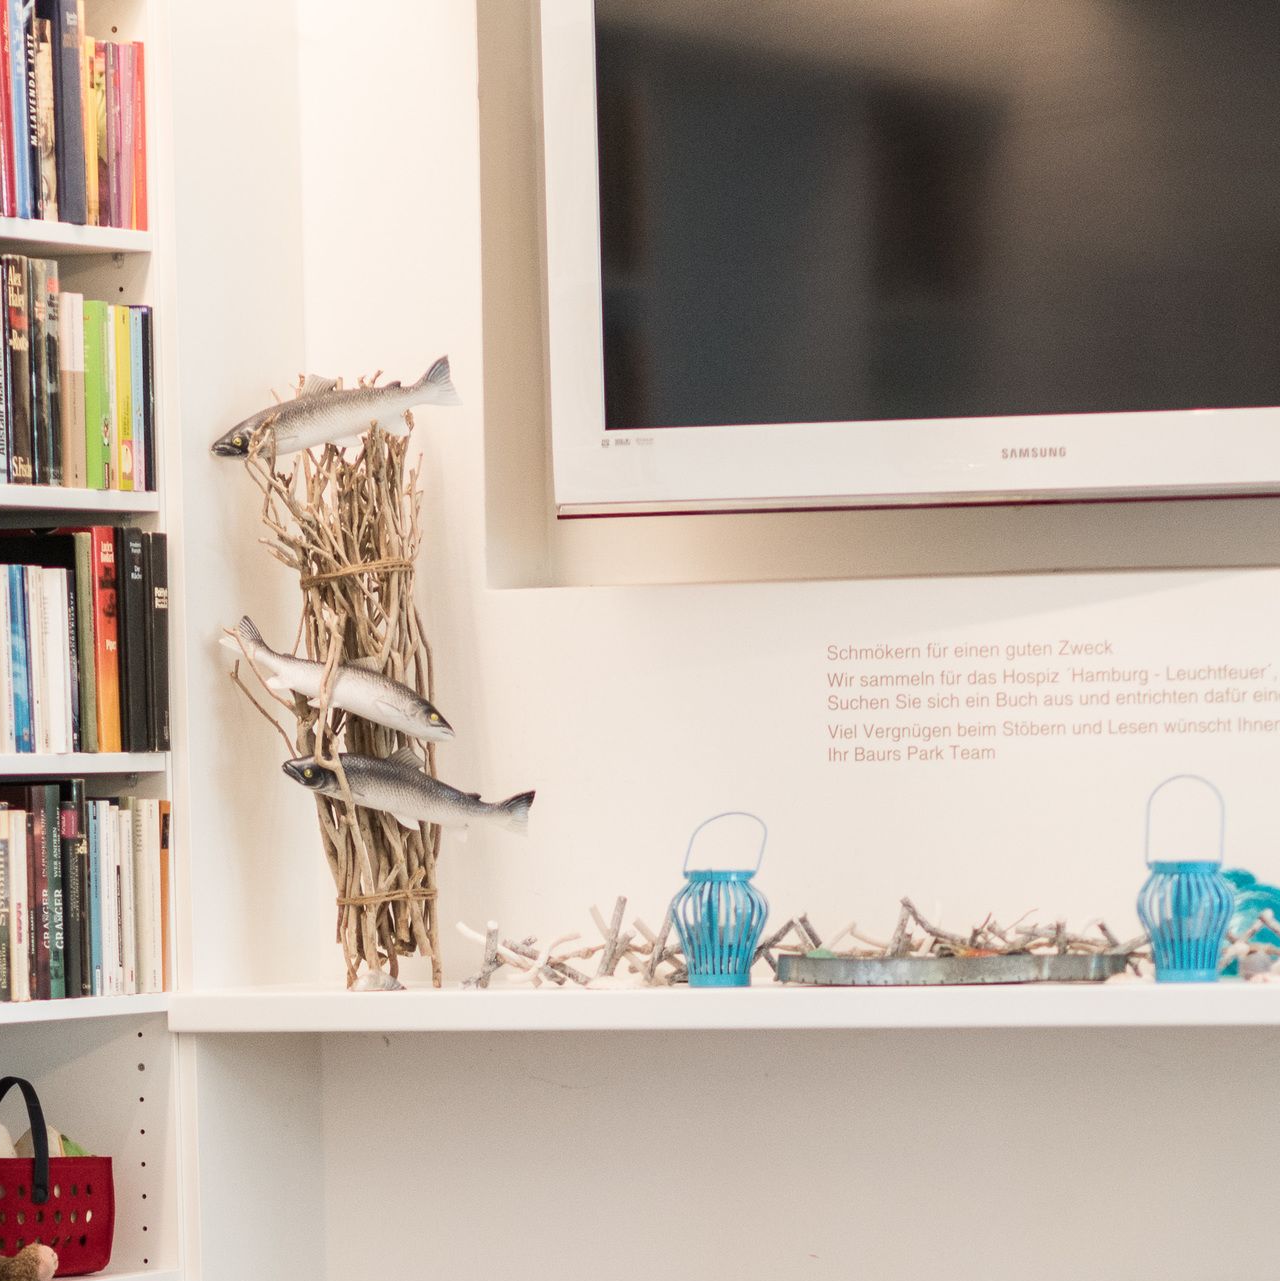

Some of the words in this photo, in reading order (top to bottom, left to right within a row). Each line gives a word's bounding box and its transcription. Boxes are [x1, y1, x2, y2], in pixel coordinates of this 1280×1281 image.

[1001, 446, 1067, 460] SAMSUNG
[827, 643, 921, 661] Schmökern
[927, 642, 949, 659] für
[954, 642, 999, 658] einen
[1006, 641, 1052, 660] guten
[827, 672, 854, 688] Wir
[860, 669, 935, 687] sammeln
[940, 669, 962, 685] für
[967, 668, 996, 684] das
[1003, 668, 1059, 687] Hospiz
[827, 693, 889, 710] Suchen
[896, 693, 921, 709] Sie
[927, 691, 959, 709] sich
[965, 692, 990, 708] ein
[996, 691, 1038, 707] Buch
[1043, 693, 1073, 706] aus
[1079, 690, 1110, 705] und
[1116, 688, 1198, 705] entrichten
[1204, 687, 1247, 704] dafür
[828, 723, 857, 739] Viel
[863, 722, 951, 742] Vergnügen
[957, 721, 996, 737] beim
[1003, 720, 1066, 736] Stöbern
[1072, 719, 1102, 735] und
[1108, 719, 1158, 735] Lesen
[1164, 717, 1232, 734] wünscht
[828, 746, 849, 762] Ihr
[854, 745, 901, 762] Baurs
[907, 744, 944, 761] Park
[950, 744, 996, 760] Team
